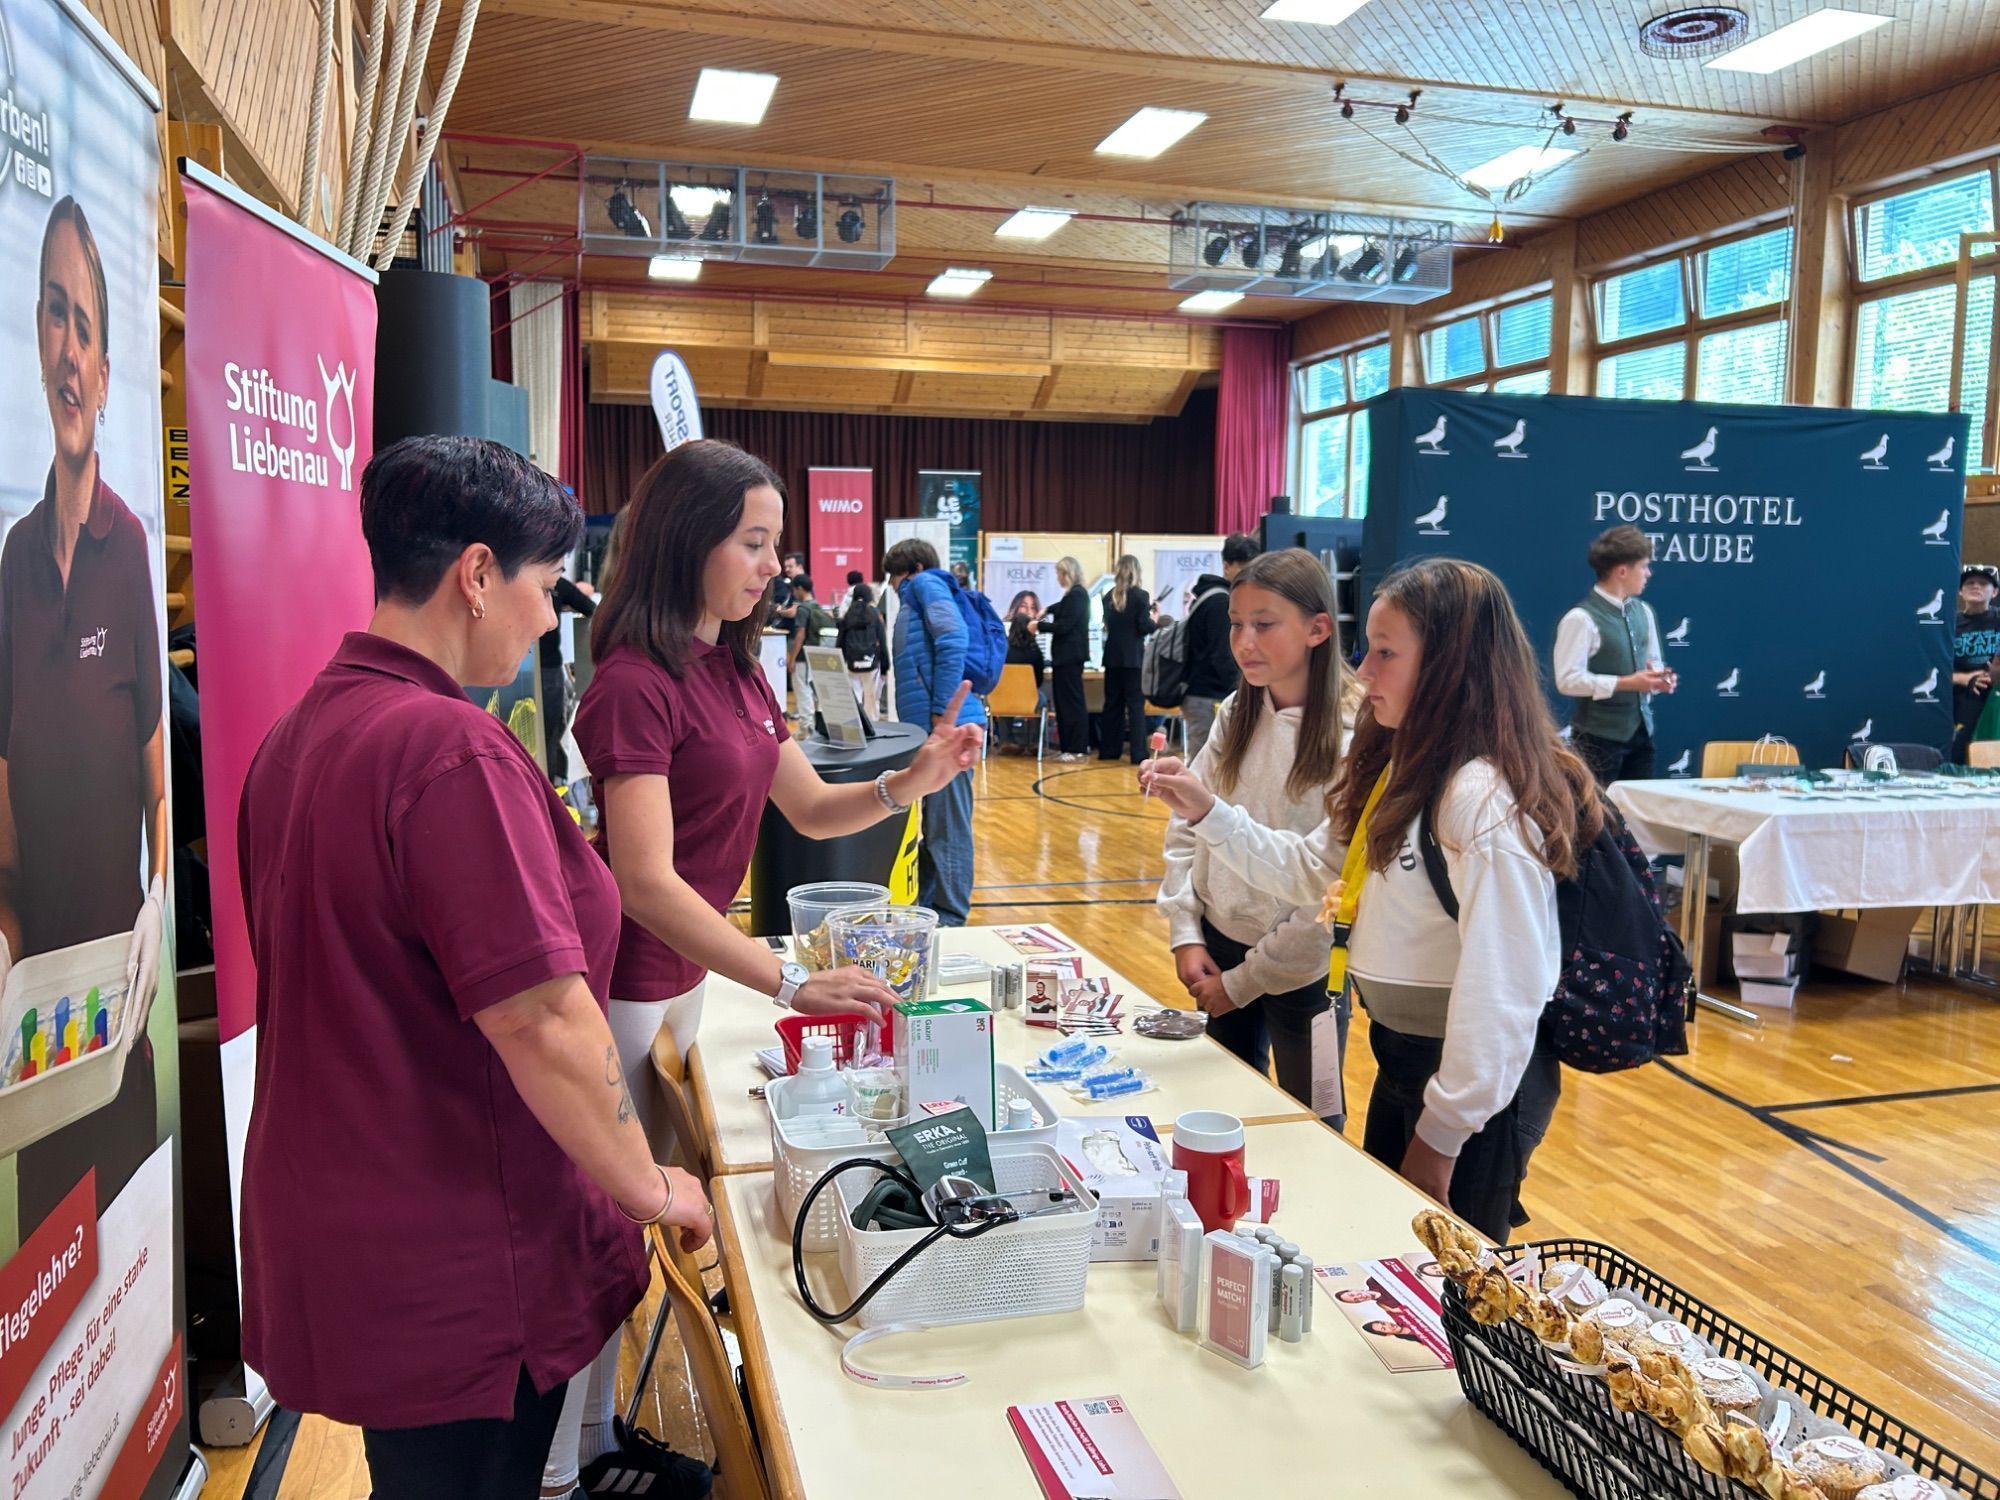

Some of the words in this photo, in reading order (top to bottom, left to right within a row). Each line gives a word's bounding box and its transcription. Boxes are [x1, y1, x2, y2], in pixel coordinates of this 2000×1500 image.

[224, 361, 318, 444] Stiftung
[229, 422, 329, 487] Liebenau
[818, 498, 864, 513] WIMO
[1594, 491, 1803, 526] POSTHOTEL
[1644, 532, 1754, 563] TAUBE
[922, 1141, 935, 1151] THE
[936, 1133, 968, 1147] ORIGINAL
[1217, 1276, 1246, 1293] PERFECT
[11, 1396, 47, 1461] Junge
[49, 1343, 83, 1404] Pflege
[86, 1317, 101, 1350] für
[102, 1286, 122, 1325] eine
[124, 1247, 148, 1295] starke
[12, 1416, 60, 1500] Zukunft
[70, 1375, 84, 1417] sei
[88, 1327, 116, 1390] dabei!
